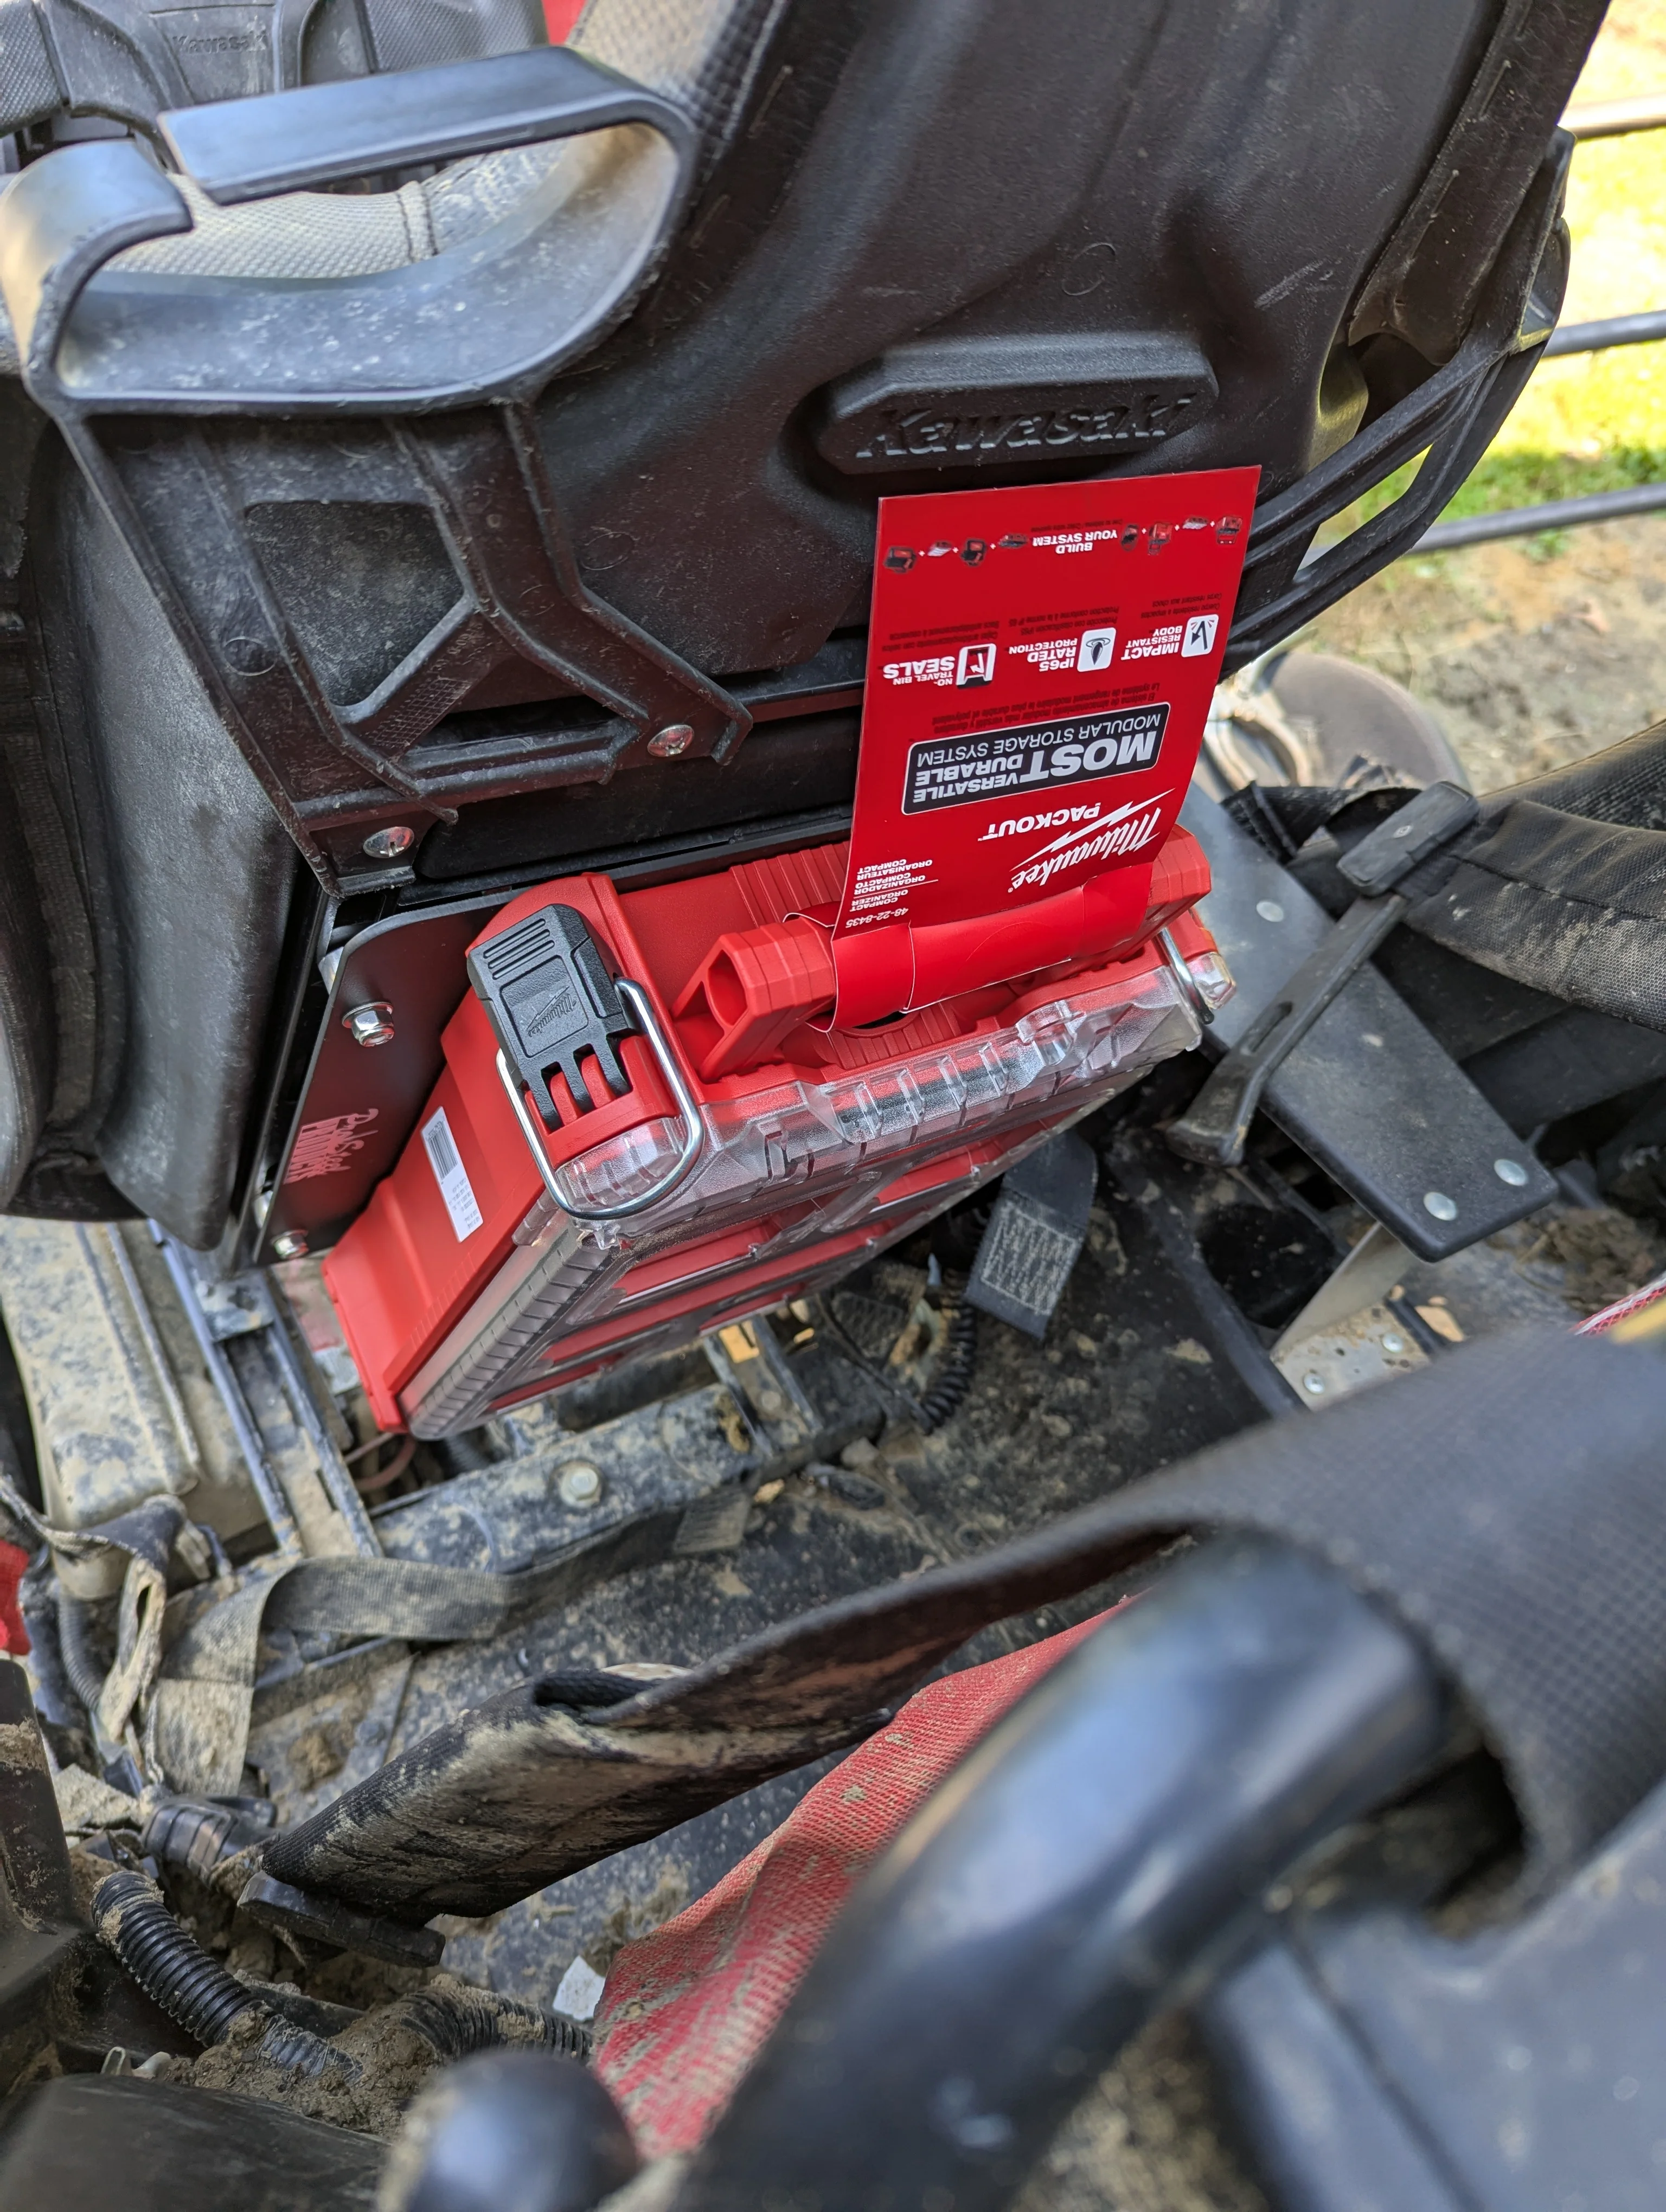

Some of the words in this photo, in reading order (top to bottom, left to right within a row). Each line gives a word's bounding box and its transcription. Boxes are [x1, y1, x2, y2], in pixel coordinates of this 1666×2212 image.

[855, 393, 1196, 458] Kawasaki
[1032, 532, 1083, 546] SYSTEM
[1084, 529, 1118, 543] YOUR
[1055, 541, 1093, 554] BUILD
[1127, 633, 1182, 648] RESISTANT
[1152, 625, 1183, 638] BODY
[1009, 638, 1078, 654] PROTECTION
[1027, 644, 1077, 663] RATED
[1120, 642, 1180, 660] IMPACT
[883, 656, 956, 679] SEALS
[1039, 657, 1075, 672] IP65
[892, 676, 913, 685] BIN
[914, 669, 953, 682] TRAVEL
[933, 677, 953, 686] NO-
[1078, 713, 1161, 740] MODULAR
[992, 728, 1074, 755] STORAGE
[917, 742, 989, 768] SYSTEM
[1019, 730, 1157, 783] MOST
[915, 754, 1024, 787] DURABLE
[913, 772, 1018, 803] VERSATILE
[982, 802, 1101, 841] PACKOUT
[1011, 807, 1162, 889] Milwaukee
[856, 859, 933, 881] ORGANISATEUR
[857, 859, 907, 874] COMPACT
[854, 872, 911, 891] COMPACTO
[854, 875, 926, 895] ORGANIZADOR
[849, 895, 901, 912] COMPACT
[851, 889, 908, 908] ORGANIZER
[845, 908, 909, 928] 48-22-8435
[528, 994, 577, 1037] Milwaukee
[284, 1118, 341, 1184] PRODUCTS
